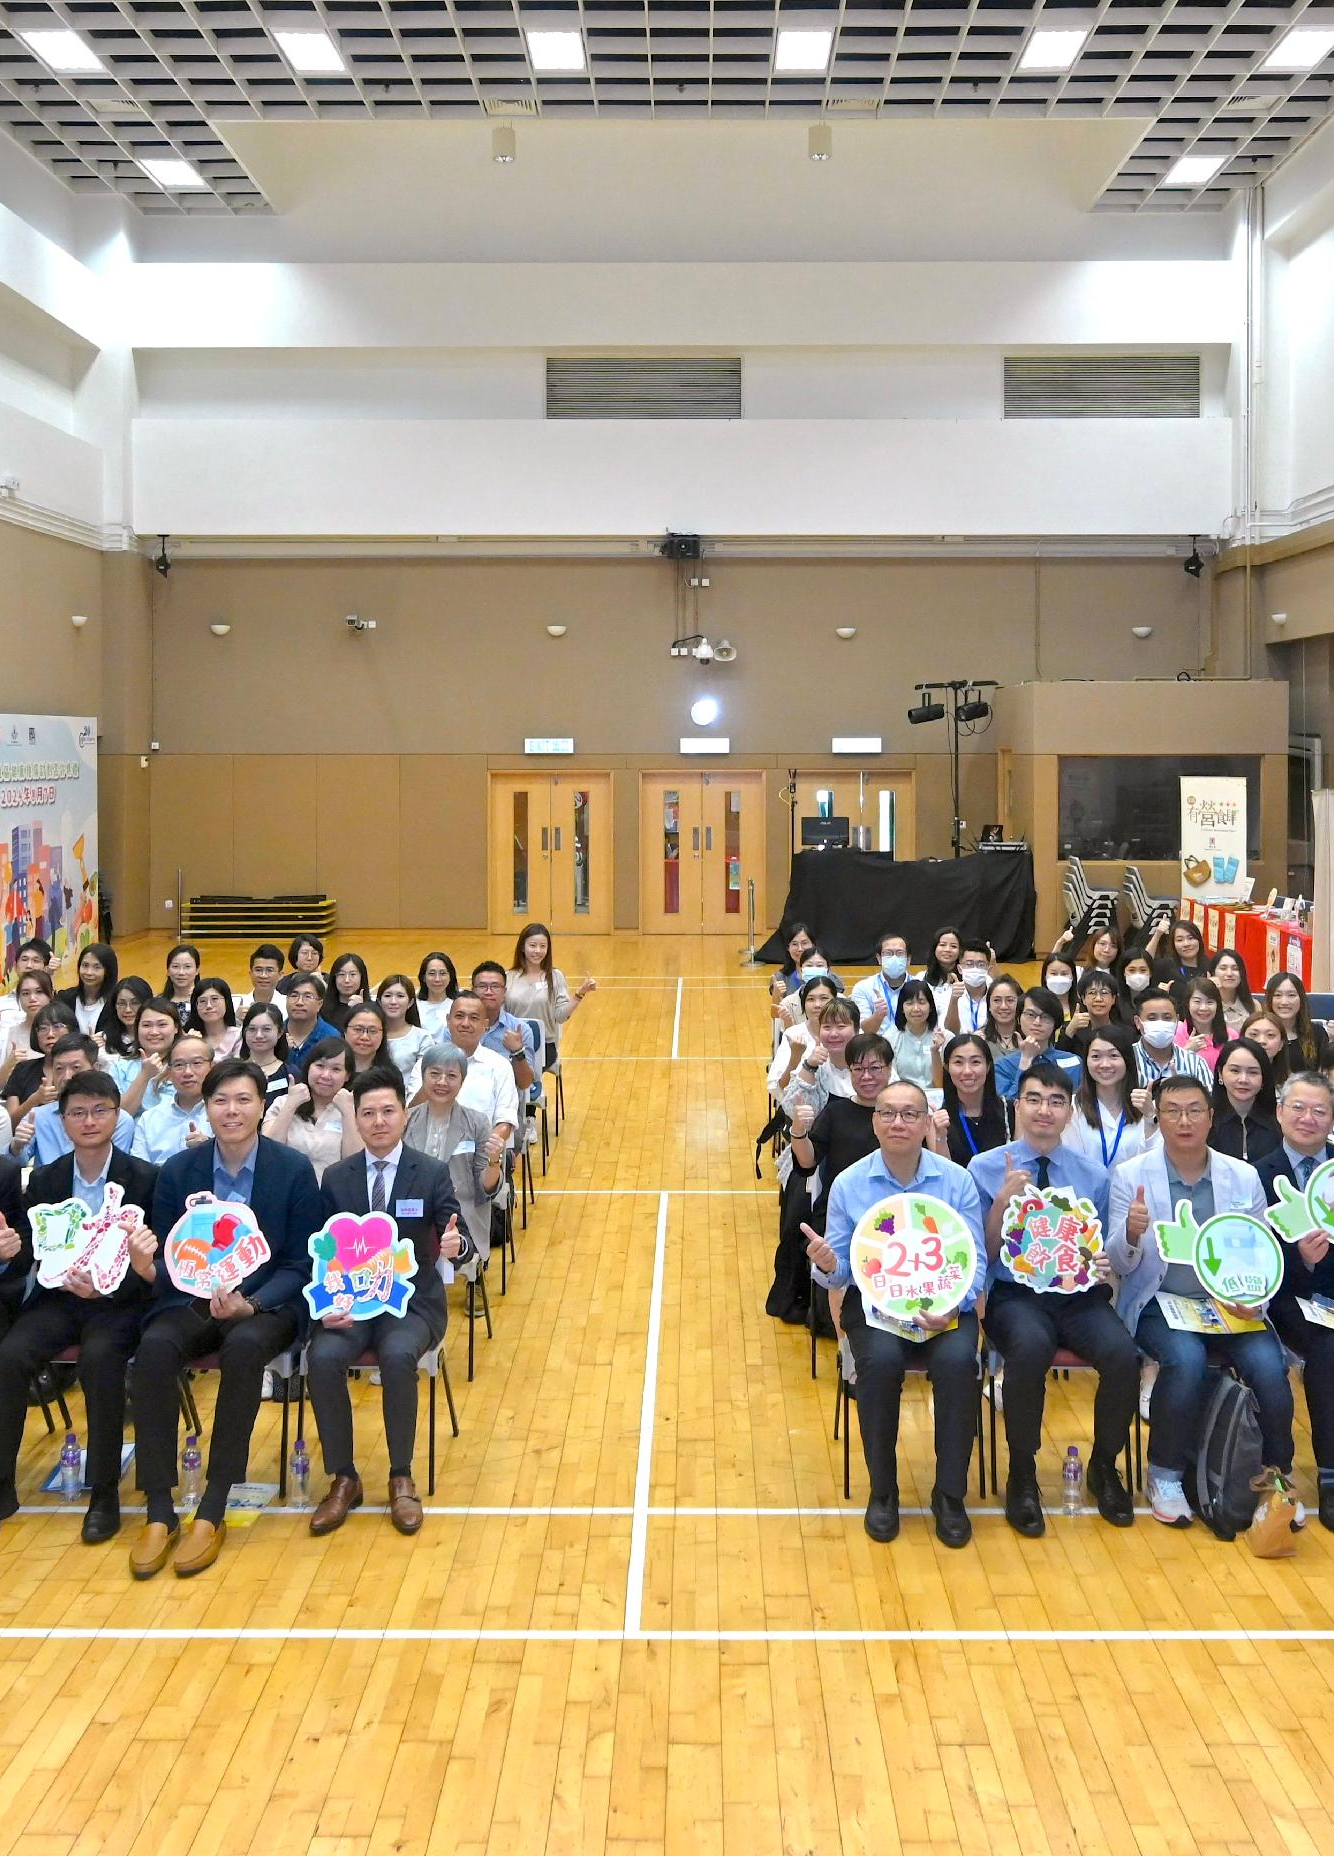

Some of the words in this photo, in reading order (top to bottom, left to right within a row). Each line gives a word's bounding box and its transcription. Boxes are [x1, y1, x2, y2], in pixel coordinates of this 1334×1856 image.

[1027, 1216, 1081, 1246] 健康
[884, 1237, 943, 1277] 2+3
[1026, 1242, 1079, 1273] 飲食
[873, 1265, 963, 1299] 日日水果蔬菜
[1222, 1275, 1263, 1292] 低鹽
